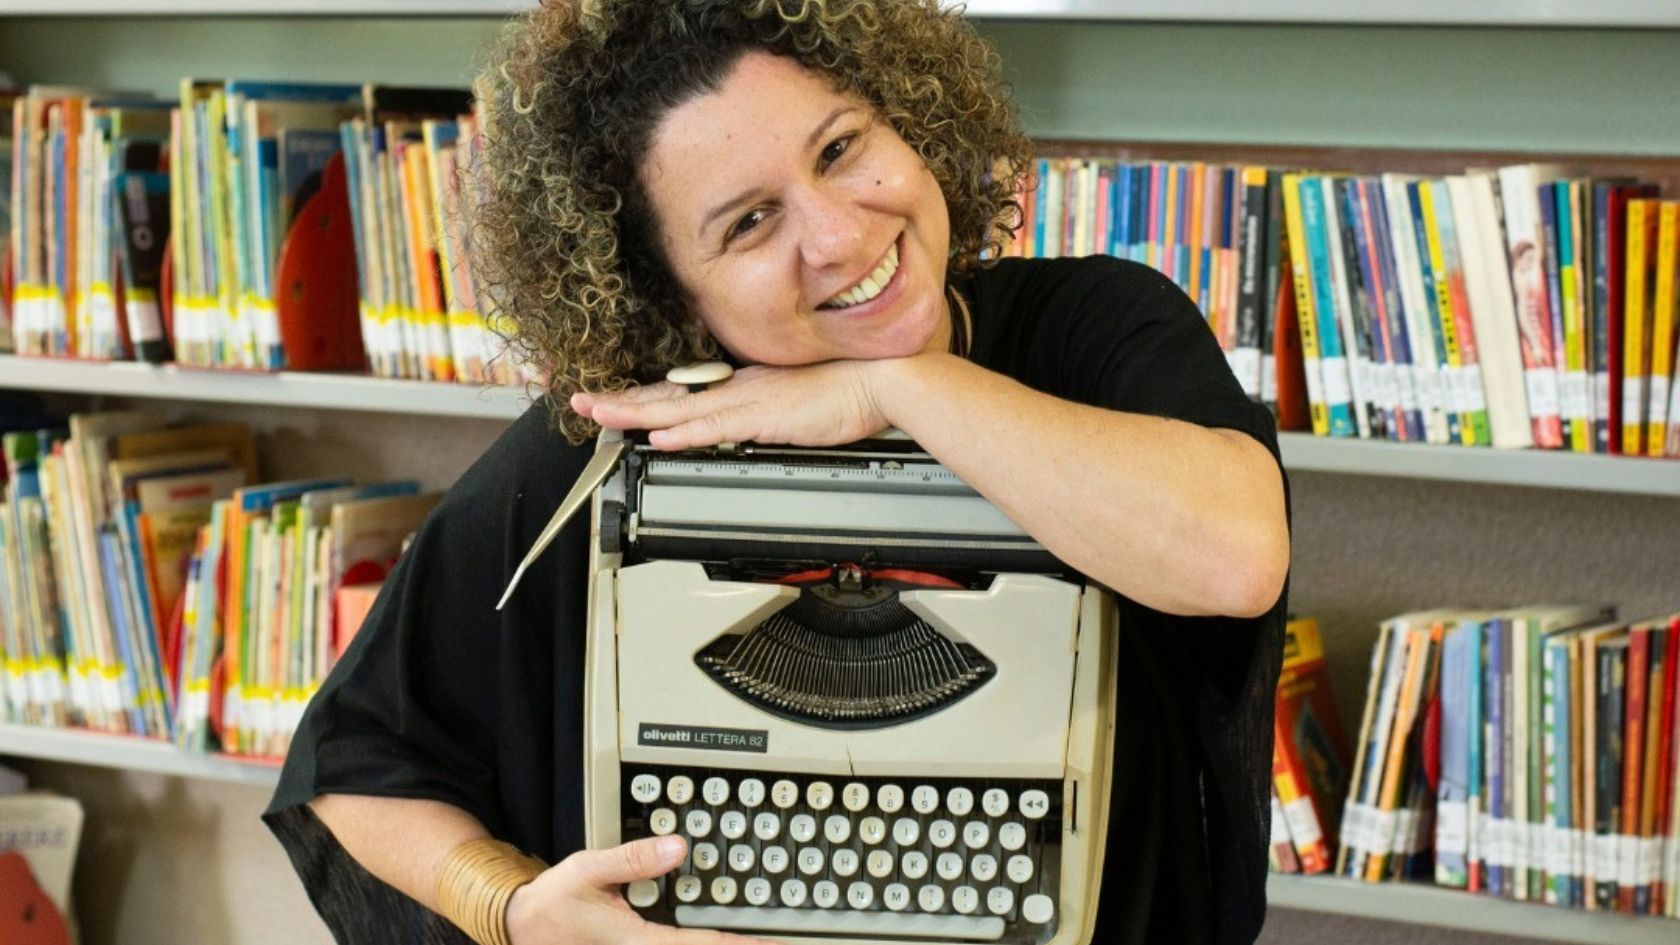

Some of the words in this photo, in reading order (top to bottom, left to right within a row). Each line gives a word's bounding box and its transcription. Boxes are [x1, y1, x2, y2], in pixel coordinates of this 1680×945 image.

[643, 729, 691, 743] olivetti
[694, 732, 746, 746] LETTERA
[749, 736, 763, 747] 82
[693, 818, 704, 828] W
[728, 820, 737, 830] E
[762, 820, 771, 830] R
[799, 823, 807, 833] T
[833, 823, 841, 834] Y
[867, 825, 877, 836] U
[937, 827, 947, 839] O
[971, 829, 981, 840] P
[700, 851, 709, 862] S
[736, 852, 746, 863] D
[770, 853, 779, 864] F
[806, 855, 815, 866] G
[840, 857, 850, 867] H
[876, 857, 884, 869] J
[910, 860, 918, 869] K
[944, 861, 953, 871] L
[979, 860, 989, 873] Ç
[682, 881, 693, 894] Z
[719, 884, 728, 895] X
[753, 885, 762, 897] C
[789, 887, 798, 898] V
[821, 888, 830, 899] B
[856, 890, 865, 900] N
[891, 891, 902, 901] M
